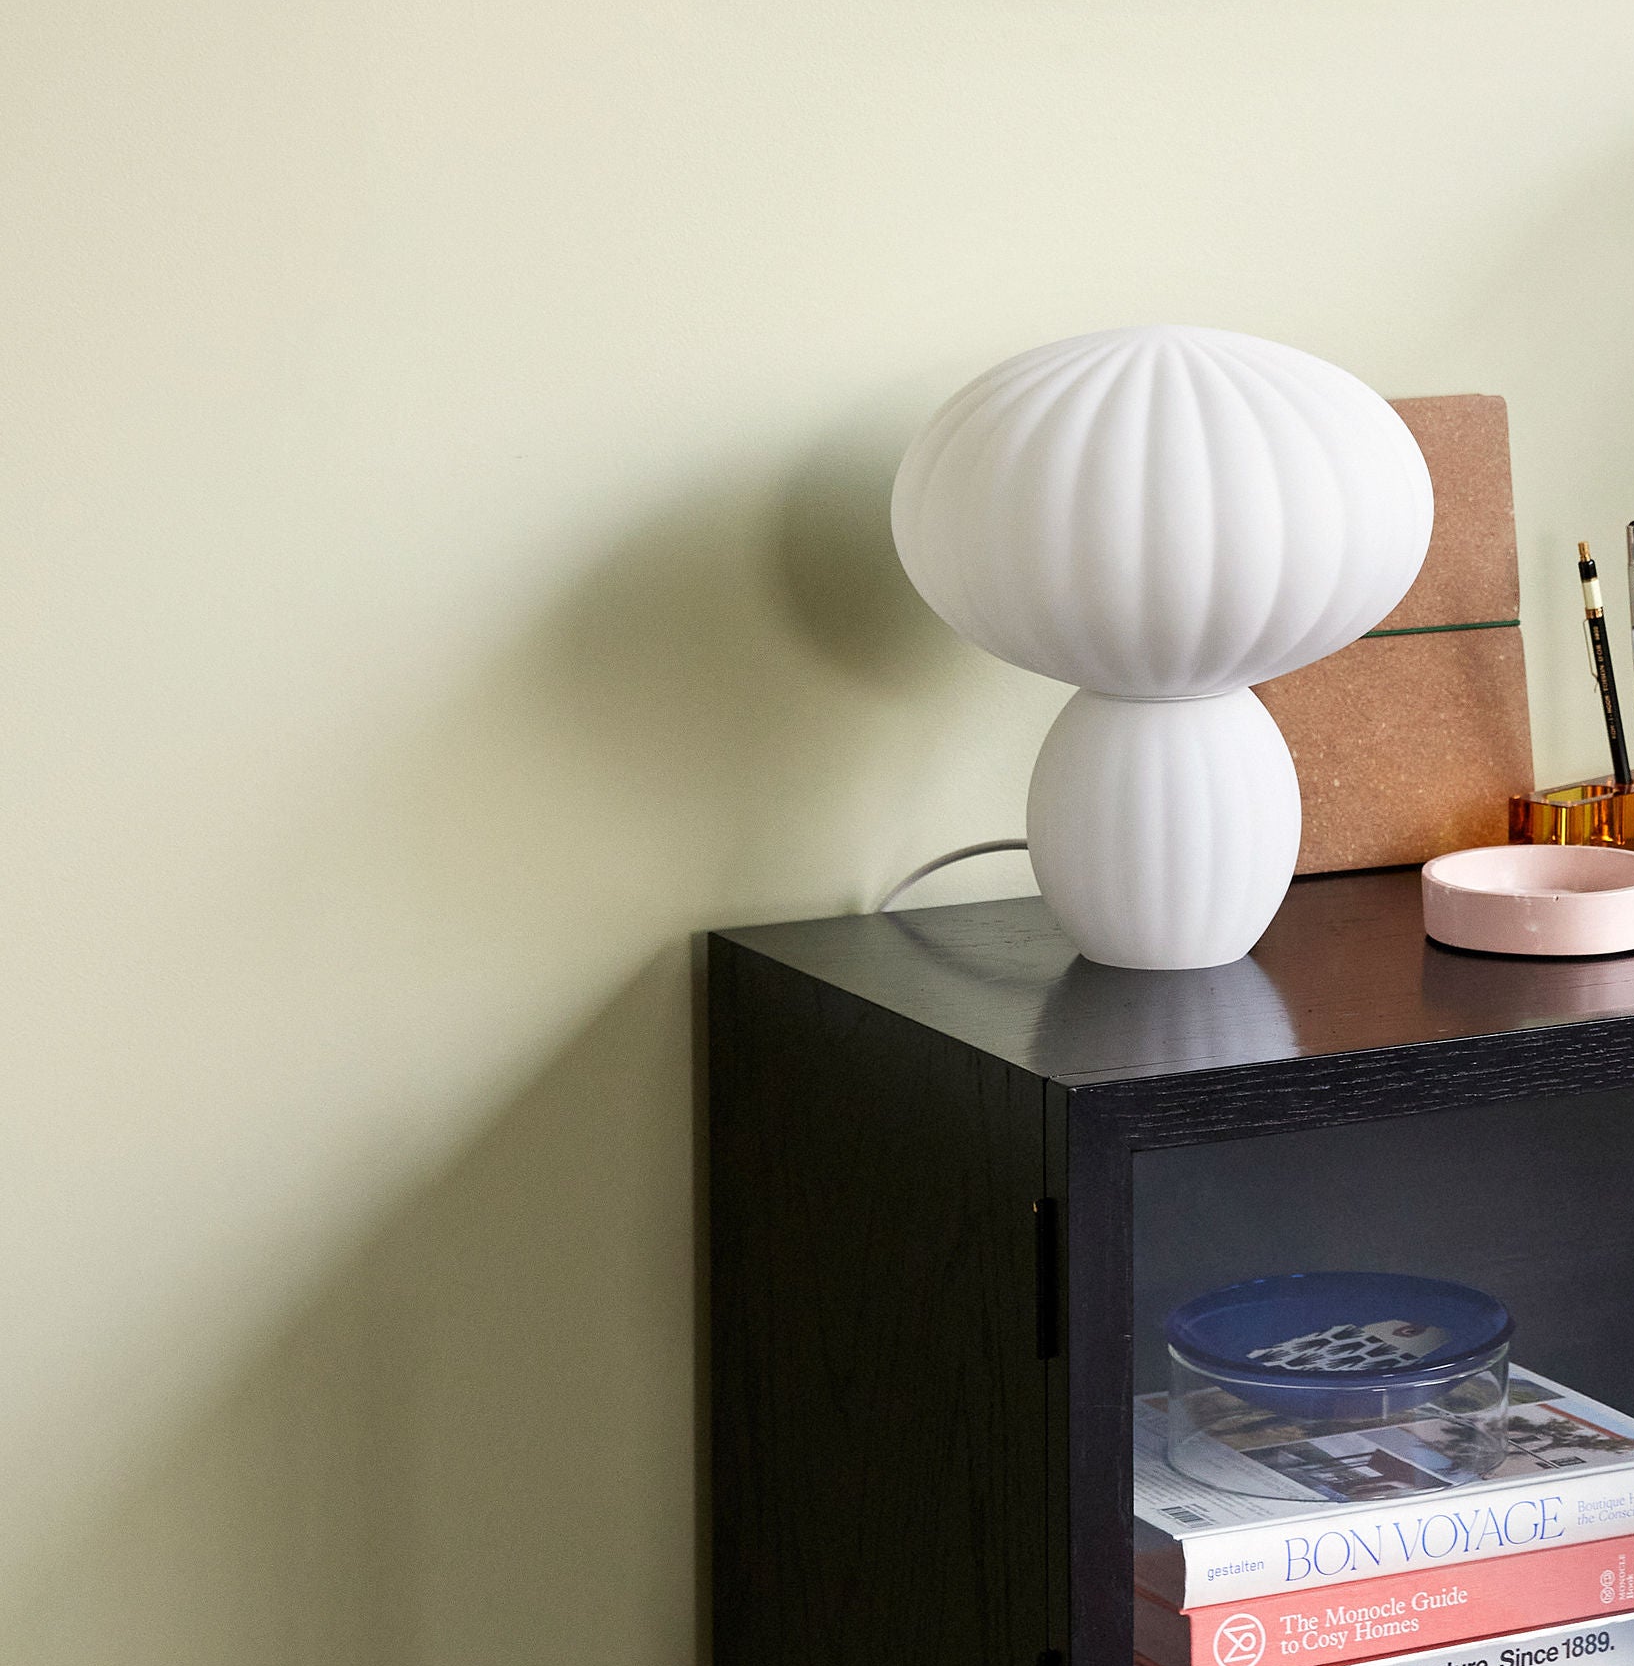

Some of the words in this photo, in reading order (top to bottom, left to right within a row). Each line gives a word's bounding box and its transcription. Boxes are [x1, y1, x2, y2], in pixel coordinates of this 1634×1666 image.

[1577, 1496, 1625, 1512] Boutique
[1577, 1513, 1595, 1525] the
[1285, 1524, 1381, 1581] BON
[1393, 1496, 1566, 1562] VOYAGE
[1207, 1559, 1264, 1581] gestalten
[1279, 1614, 1319, 1635] The
[1325, 1597, 1406, 1627] Monocle
[1411, 1586, 1468, 1612] Guide
[1280, 1639, 1299, 1655] to
[1302, 1629, 1349, 1650] Cosy
[1354, 1617, 1420, 1641] Homes
[1561, 1631, 1615, 1659] 1889.
